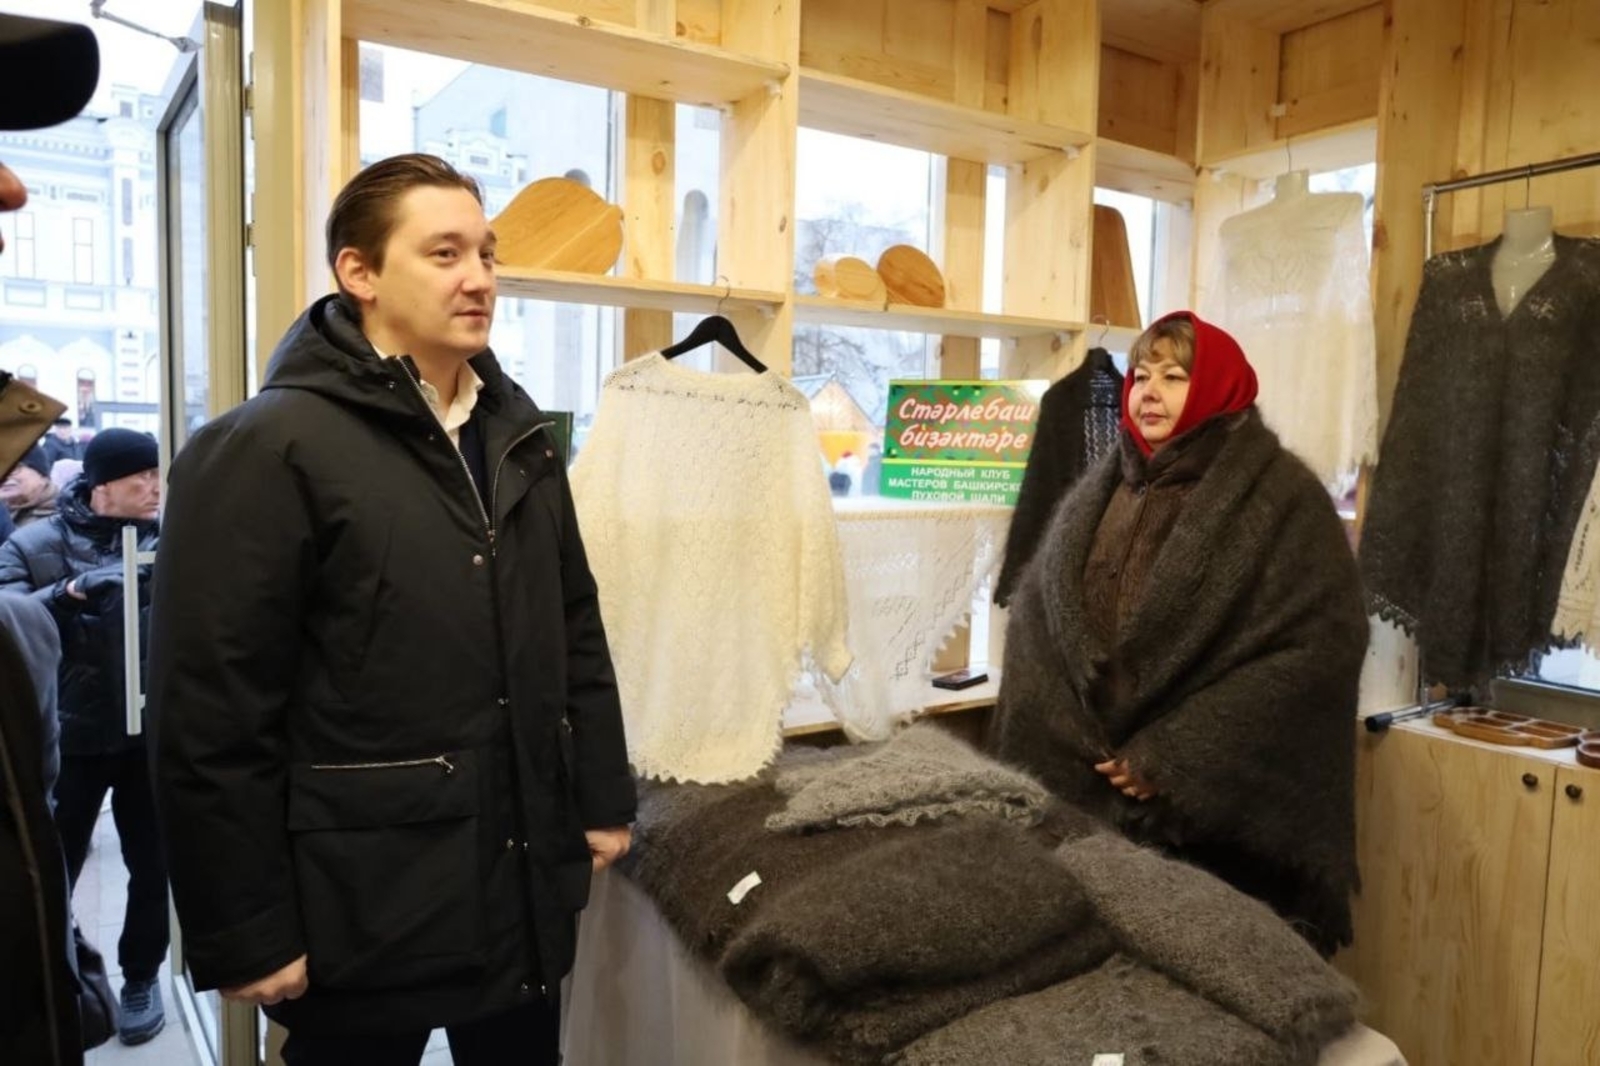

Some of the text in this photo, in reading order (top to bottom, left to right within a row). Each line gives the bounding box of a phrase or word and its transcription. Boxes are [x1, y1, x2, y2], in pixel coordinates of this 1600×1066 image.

[899, 398, 1034, 425] Стәрлебаш
[911, 467, 1011, 479] НАРОДНЫЙ КЛУБ
[888, 478, 948, 489] МАСТЕРОВ
[911, 490, 1006, 504] ПУХОВОЙ ШАЛИ
